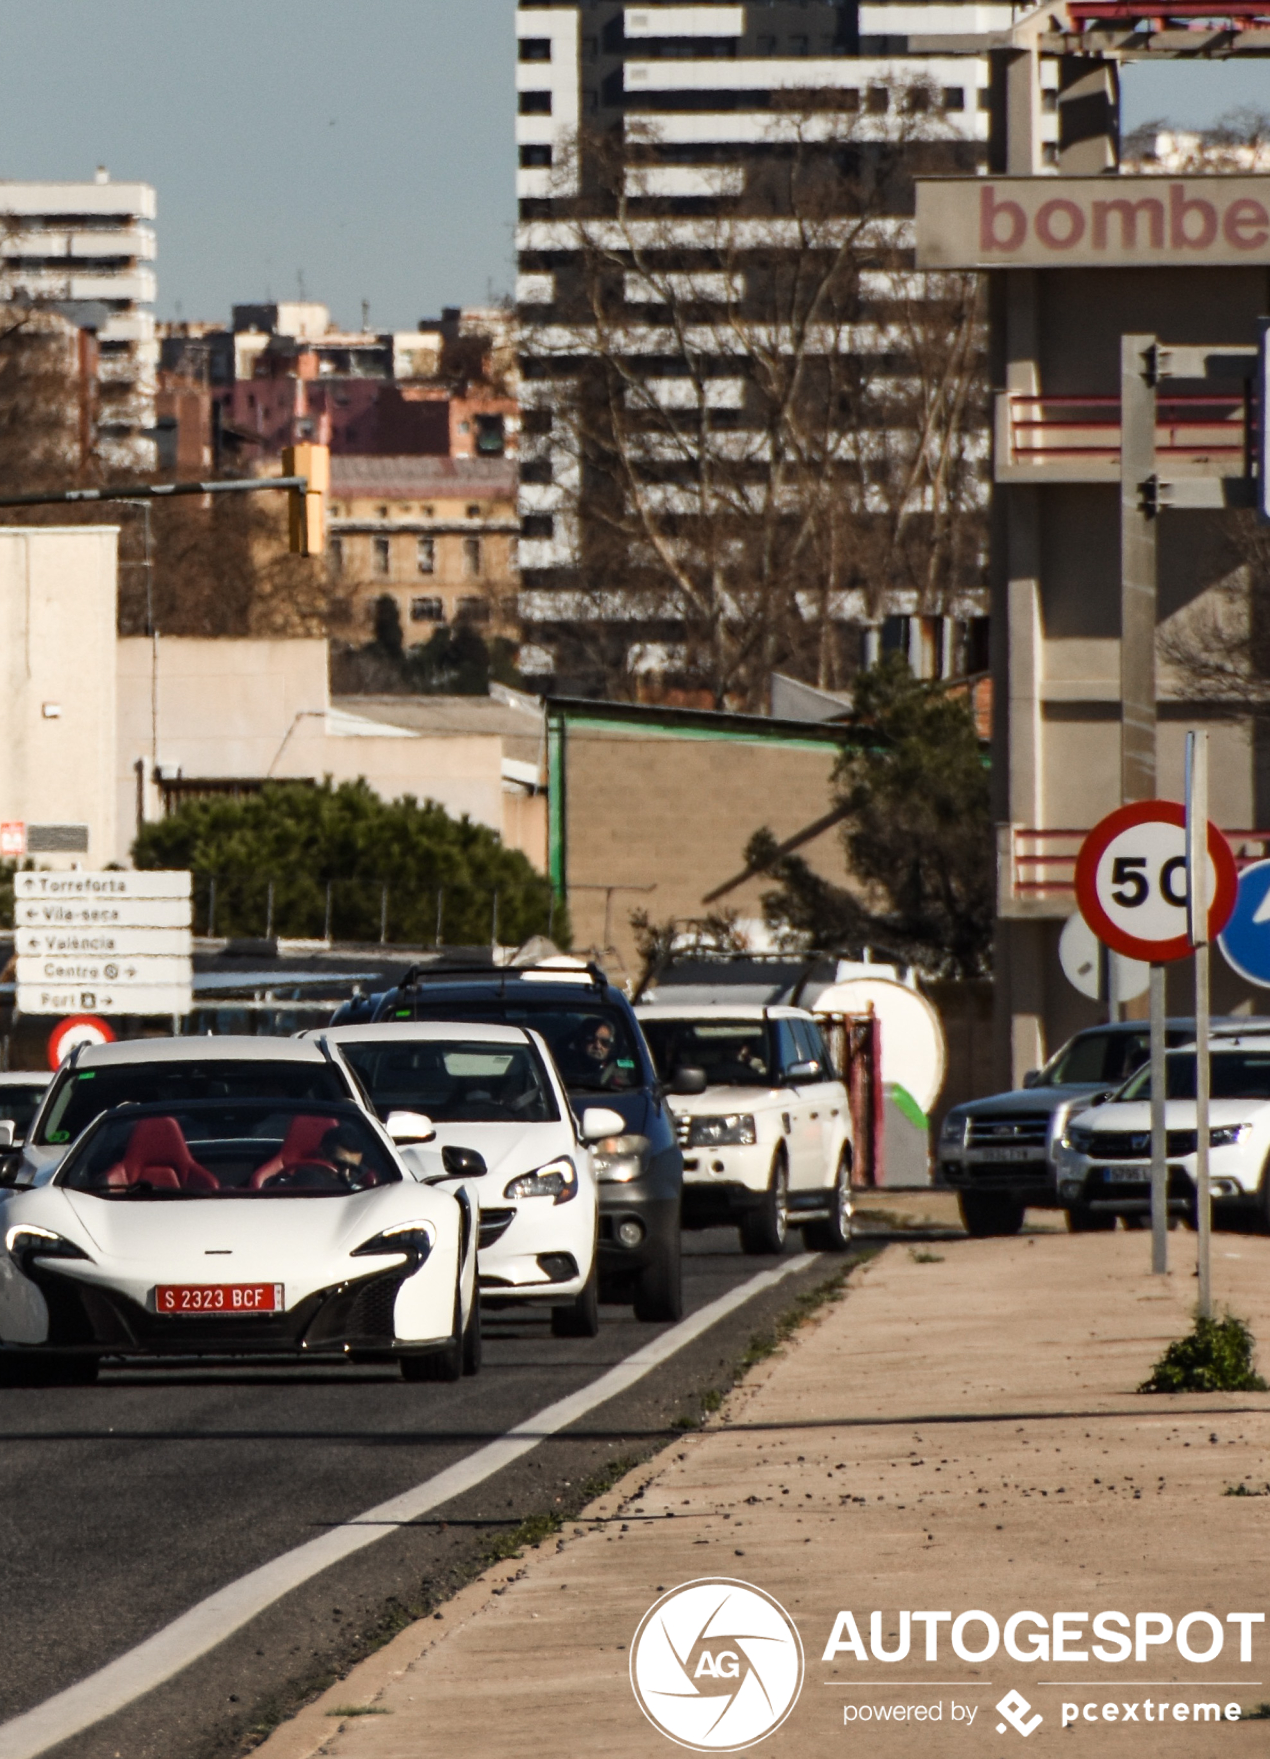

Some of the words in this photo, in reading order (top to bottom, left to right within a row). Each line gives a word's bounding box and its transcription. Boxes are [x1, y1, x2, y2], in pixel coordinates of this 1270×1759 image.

[39, 878, 127, 892] Torreforta
[1111, 856, 1188, 908] 50
[42, 906, 119, 921] Vila-seca
[165, 1291, 175, 1308] S
[181, 1290, 224, 1308] 2323
[232, 1289, 264, 1307] BCF
